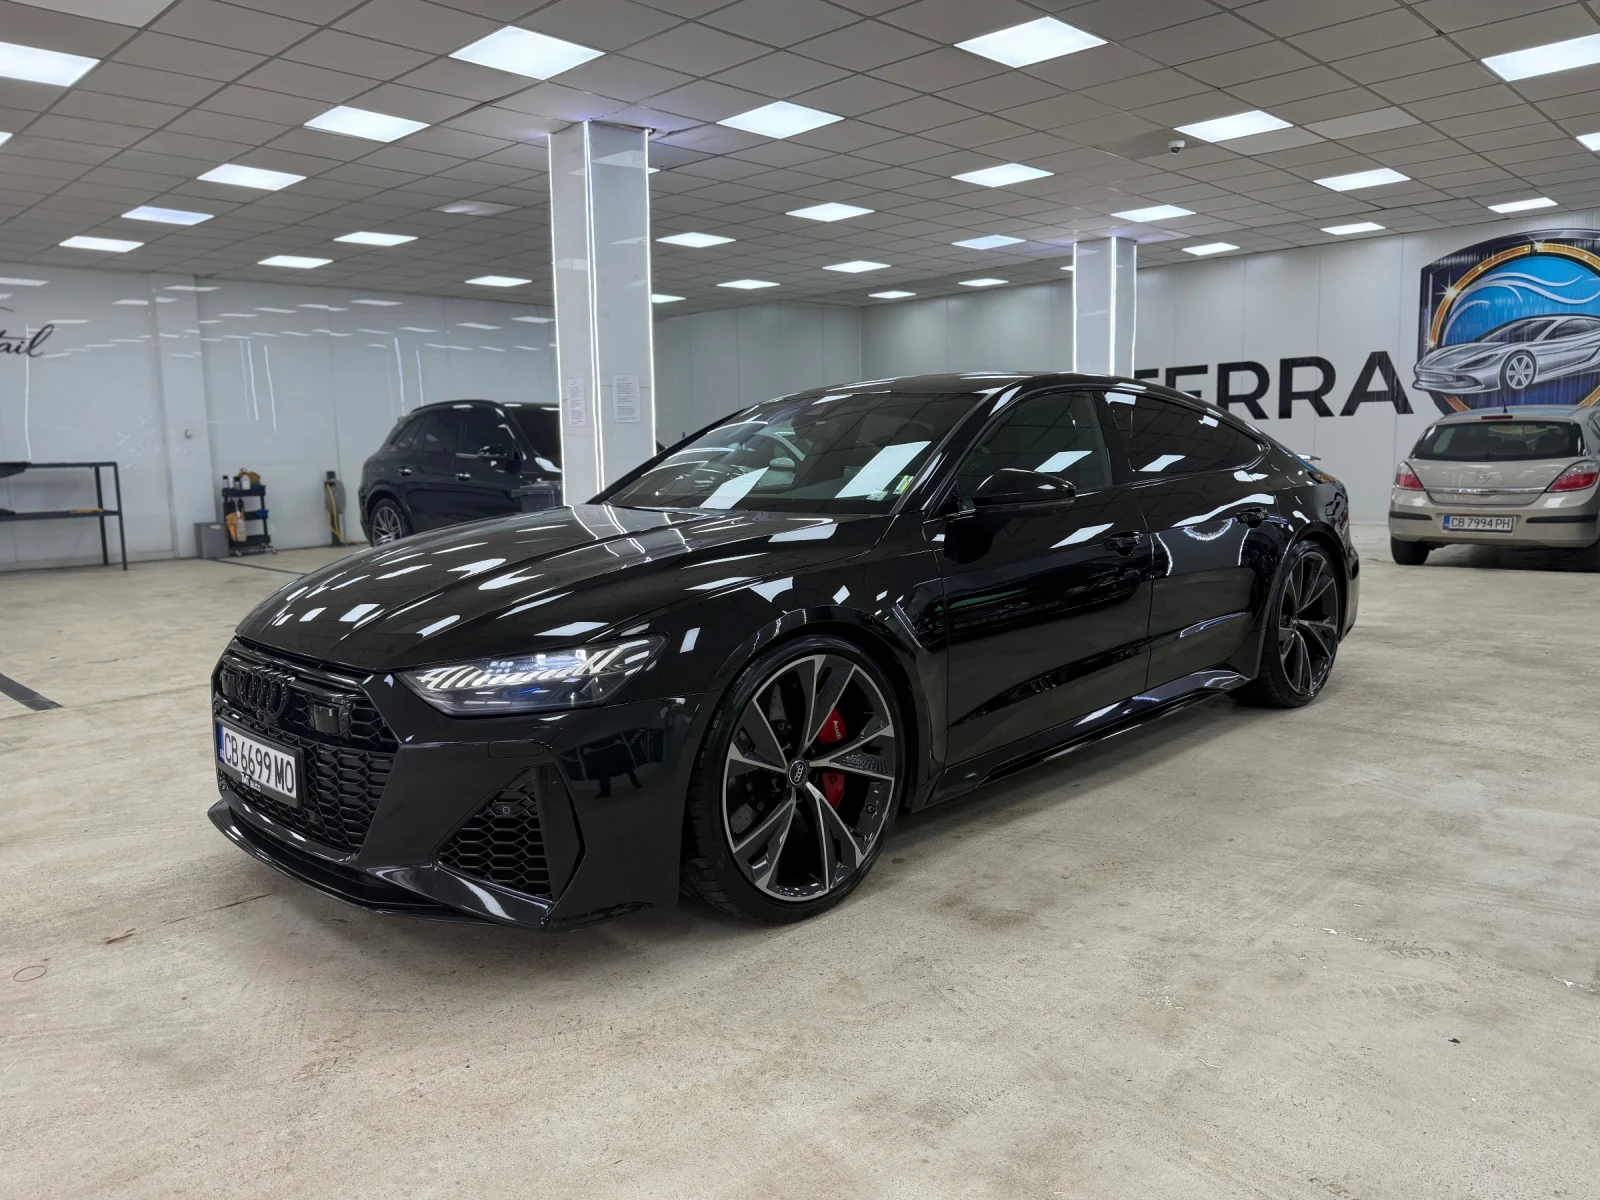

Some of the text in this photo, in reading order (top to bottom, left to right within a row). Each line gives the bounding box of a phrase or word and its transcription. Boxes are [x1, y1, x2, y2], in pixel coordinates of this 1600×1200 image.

[1134, 351, 1414, 420] ERRA
[1451, 517, 1511, 529] CB 7994 PH
[833, 720, 842, 740] Audi
[224, 732, 295, 793] CB 6699 MO
